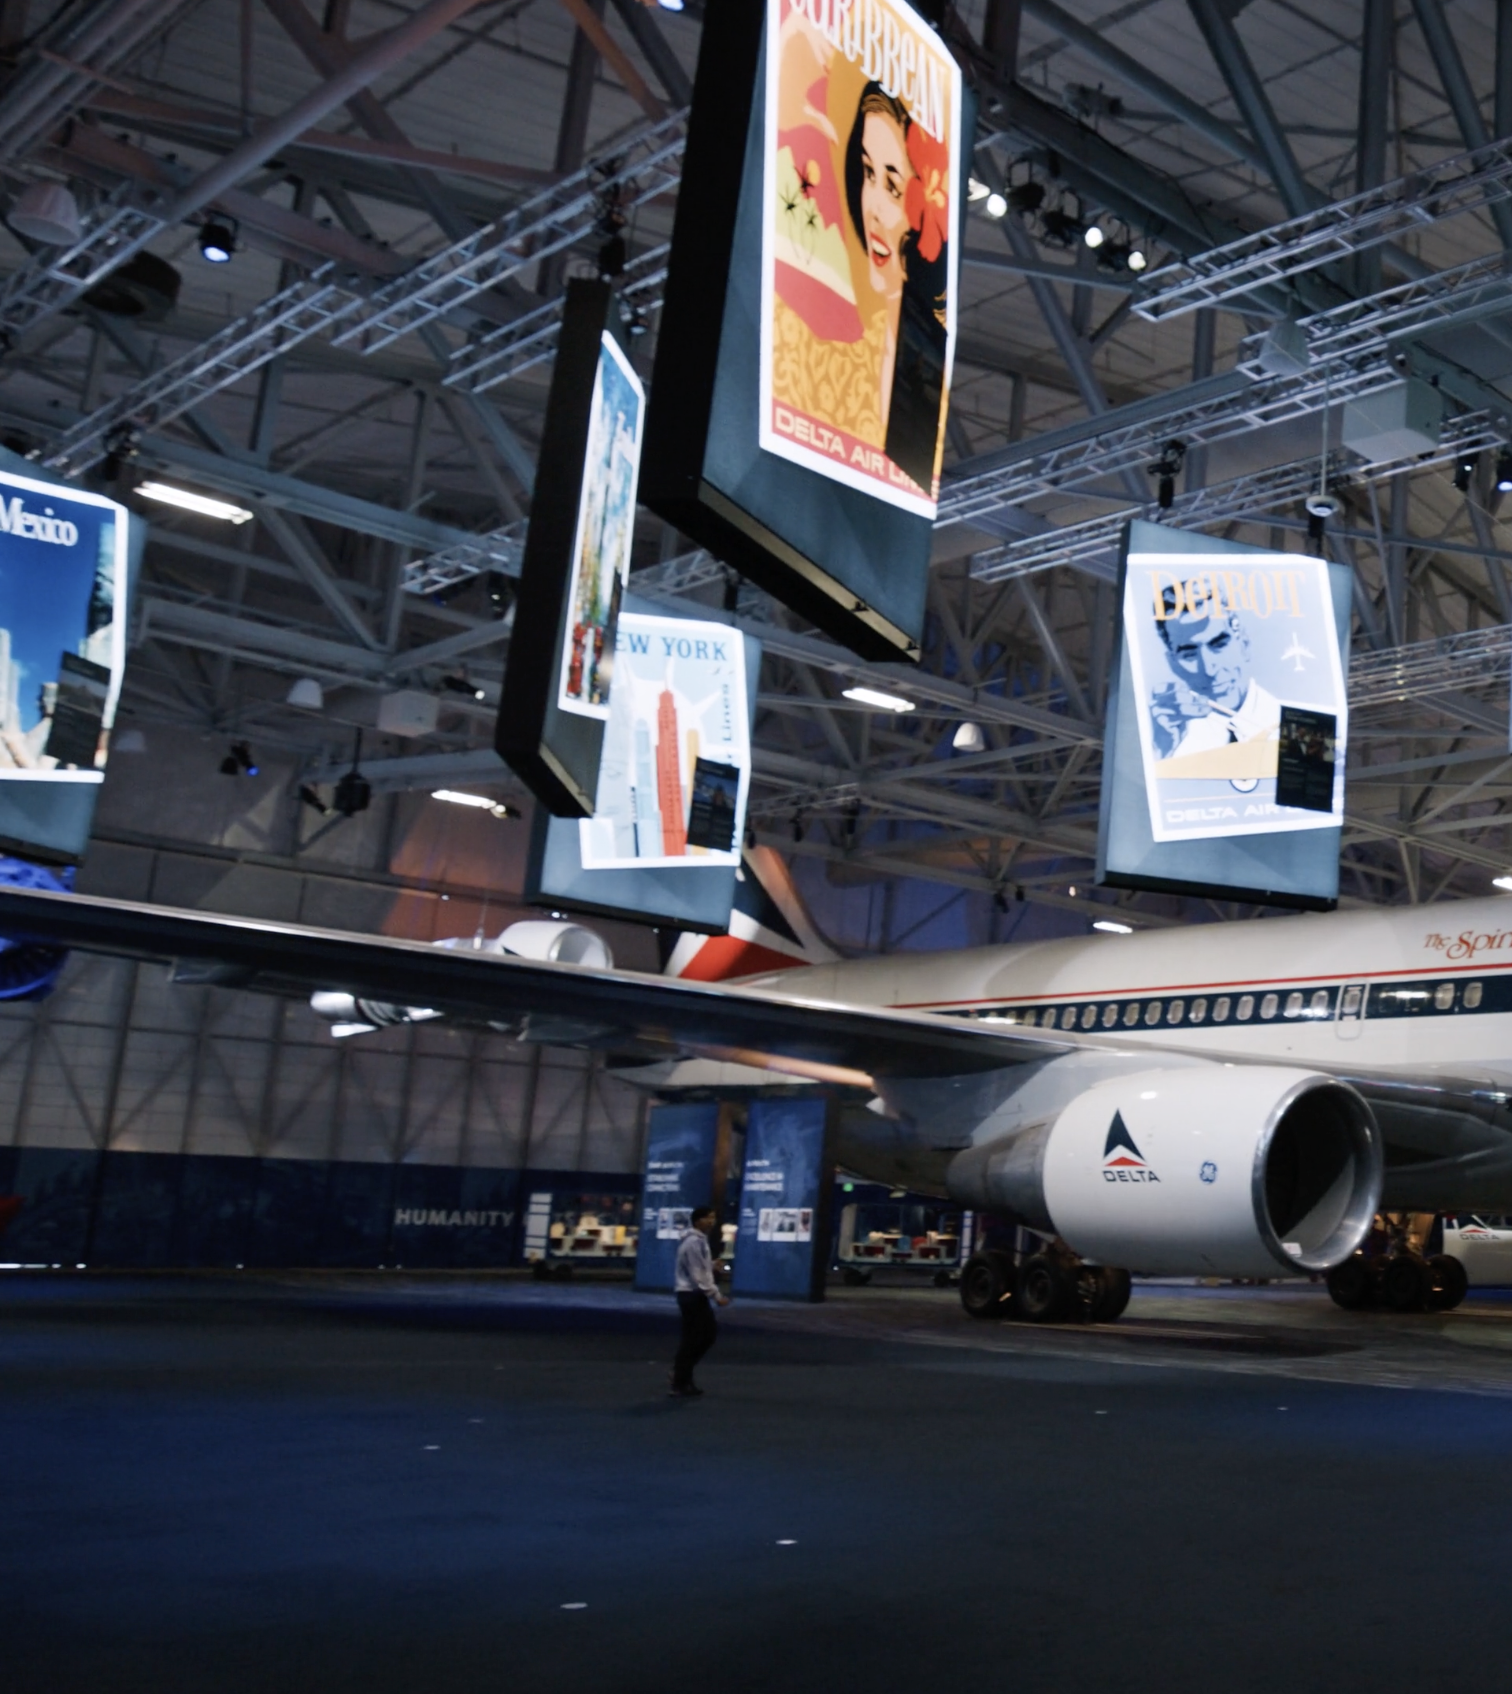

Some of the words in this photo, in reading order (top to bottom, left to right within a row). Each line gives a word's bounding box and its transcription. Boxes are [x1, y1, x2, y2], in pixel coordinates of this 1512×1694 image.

[774, 406, 847, 460] DELTA
[849, 445, 885, 477] AIR
[0, 492, 79, 547] Mexico
[661, 636, 728, 661] YORK
[1165, 806, 1239, 823] DELTA
[1243, 803, 1280, 818] AIR
[1423, 932, 1452, 949] The
[1102, 1170, 1162, 1183] DELTA
[394, 1208, 514, 1227] HUMANITY
